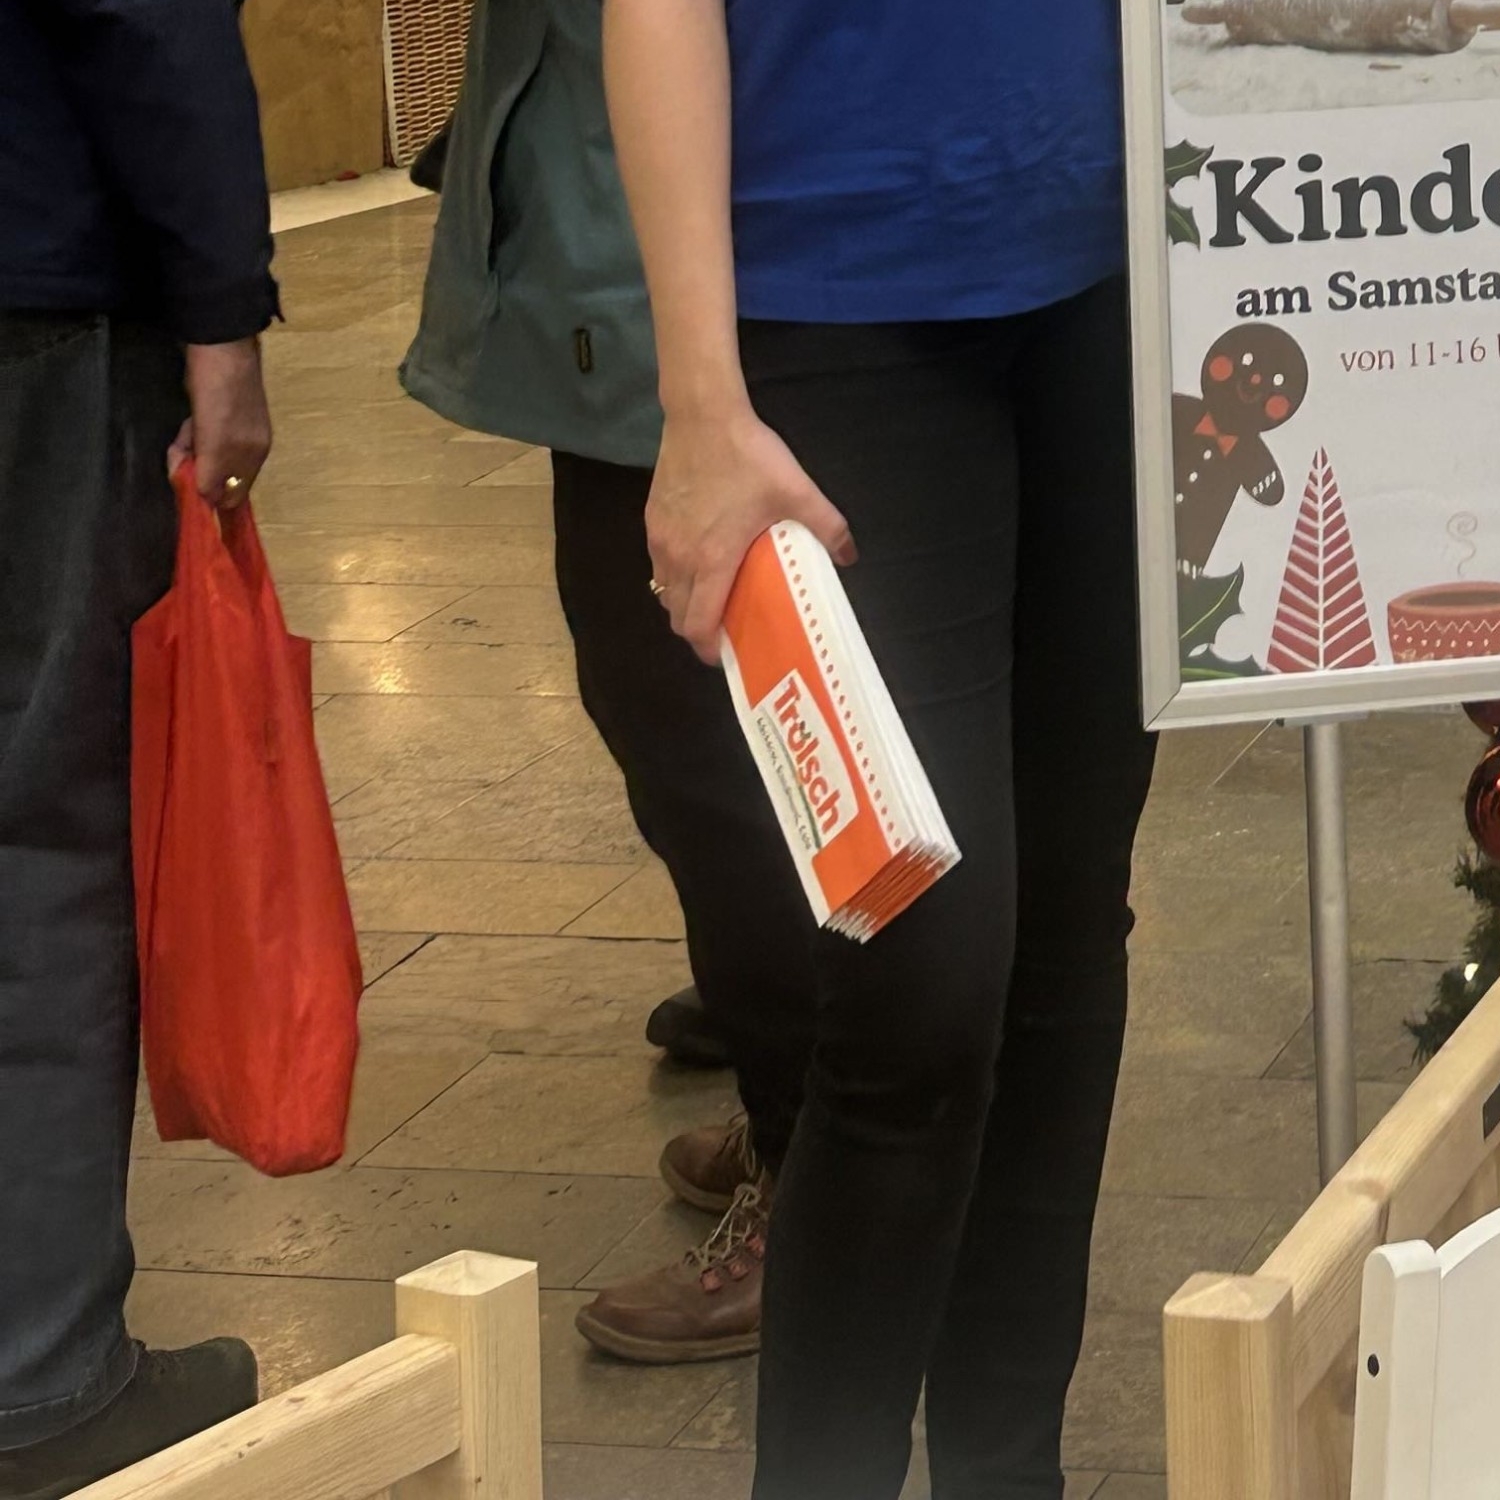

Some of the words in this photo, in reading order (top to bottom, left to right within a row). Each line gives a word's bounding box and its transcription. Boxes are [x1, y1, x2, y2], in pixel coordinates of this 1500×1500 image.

[1235, 282, 1312, 318] am
[1340, 347, 1395, 373] von
[1409, 336, 1486, 368] 11-16
[774, 676, 842, 836] Trölsch
